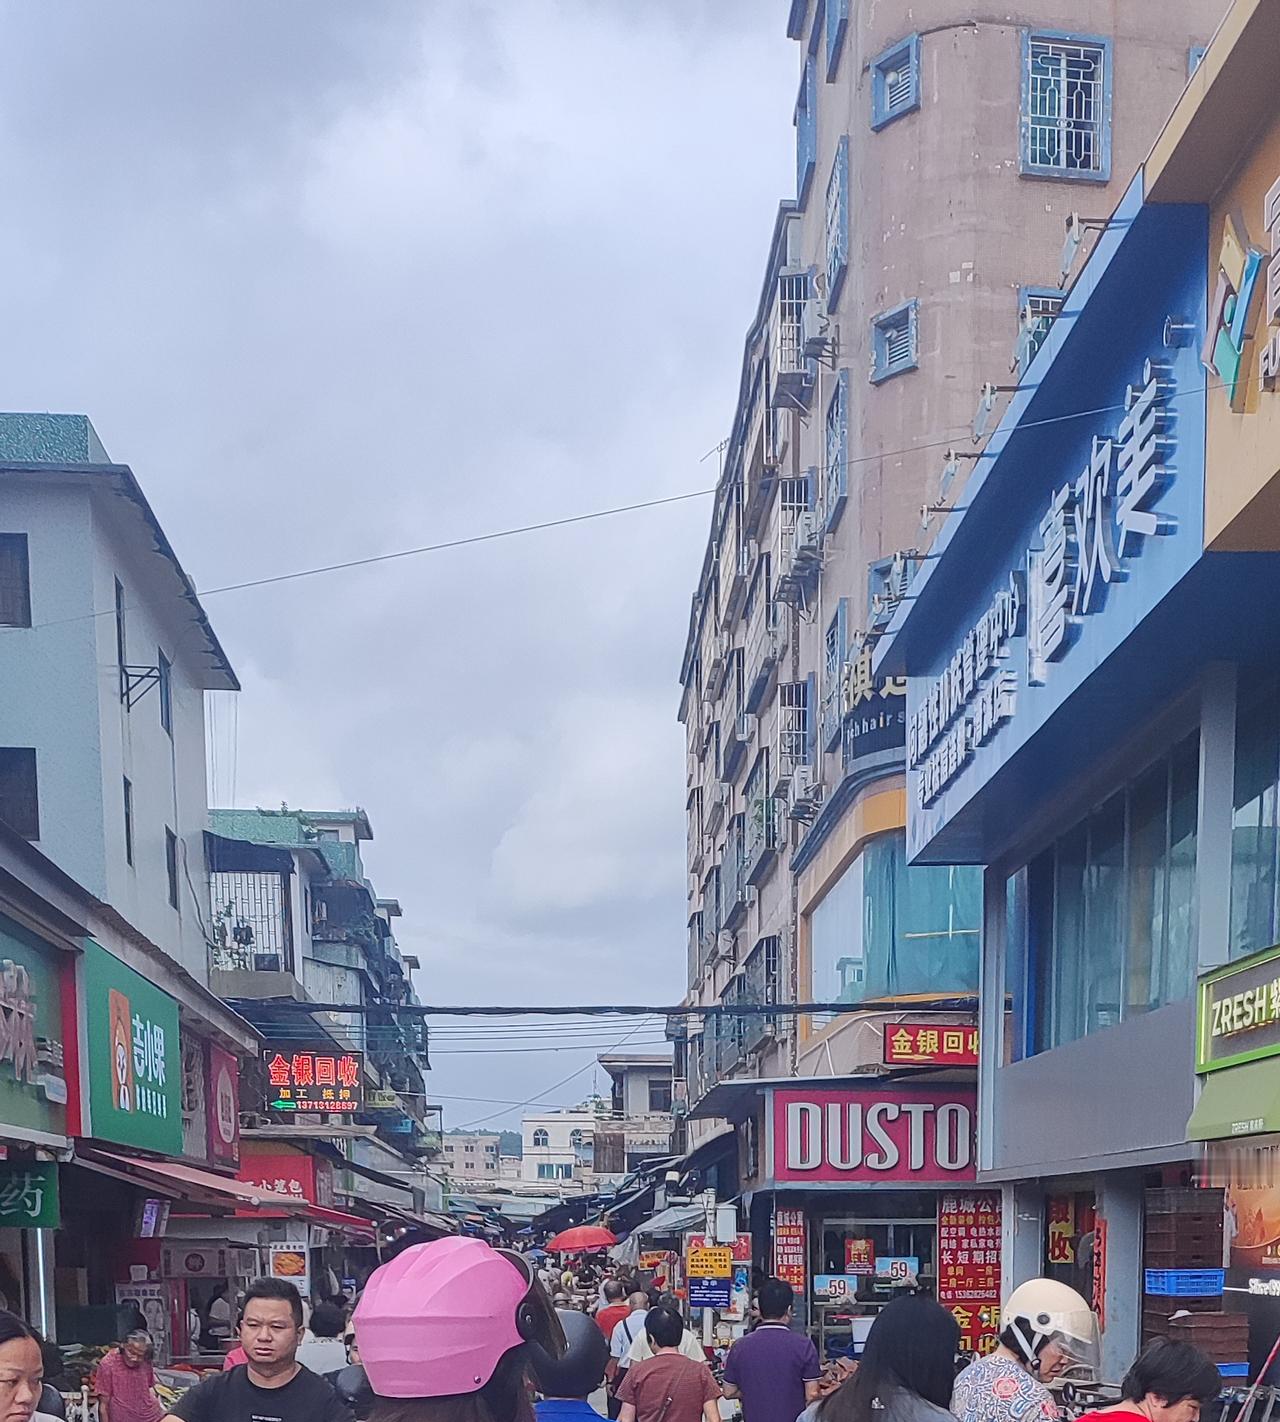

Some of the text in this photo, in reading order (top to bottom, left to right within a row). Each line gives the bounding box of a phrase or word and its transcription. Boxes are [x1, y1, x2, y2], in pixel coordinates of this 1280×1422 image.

[1040, 357, 1157, 662] 喜欢美
[1212, 985, 1266, 1037] ZRESH
[268, 1053, 360, 1087] 金银回收
[279, 1087, 351, 1100] 加工 抵押
[786, 1102, 971, 1170] DUSTO
[0, 1172, 46, 1217] 药
[244, 1178, 303, 1193] 小笼包
[890, 1261, 908, 1278] 59
[941, 1250, 1001, 1264] 长短期招
[828, 1279, 847, 1296] 59
